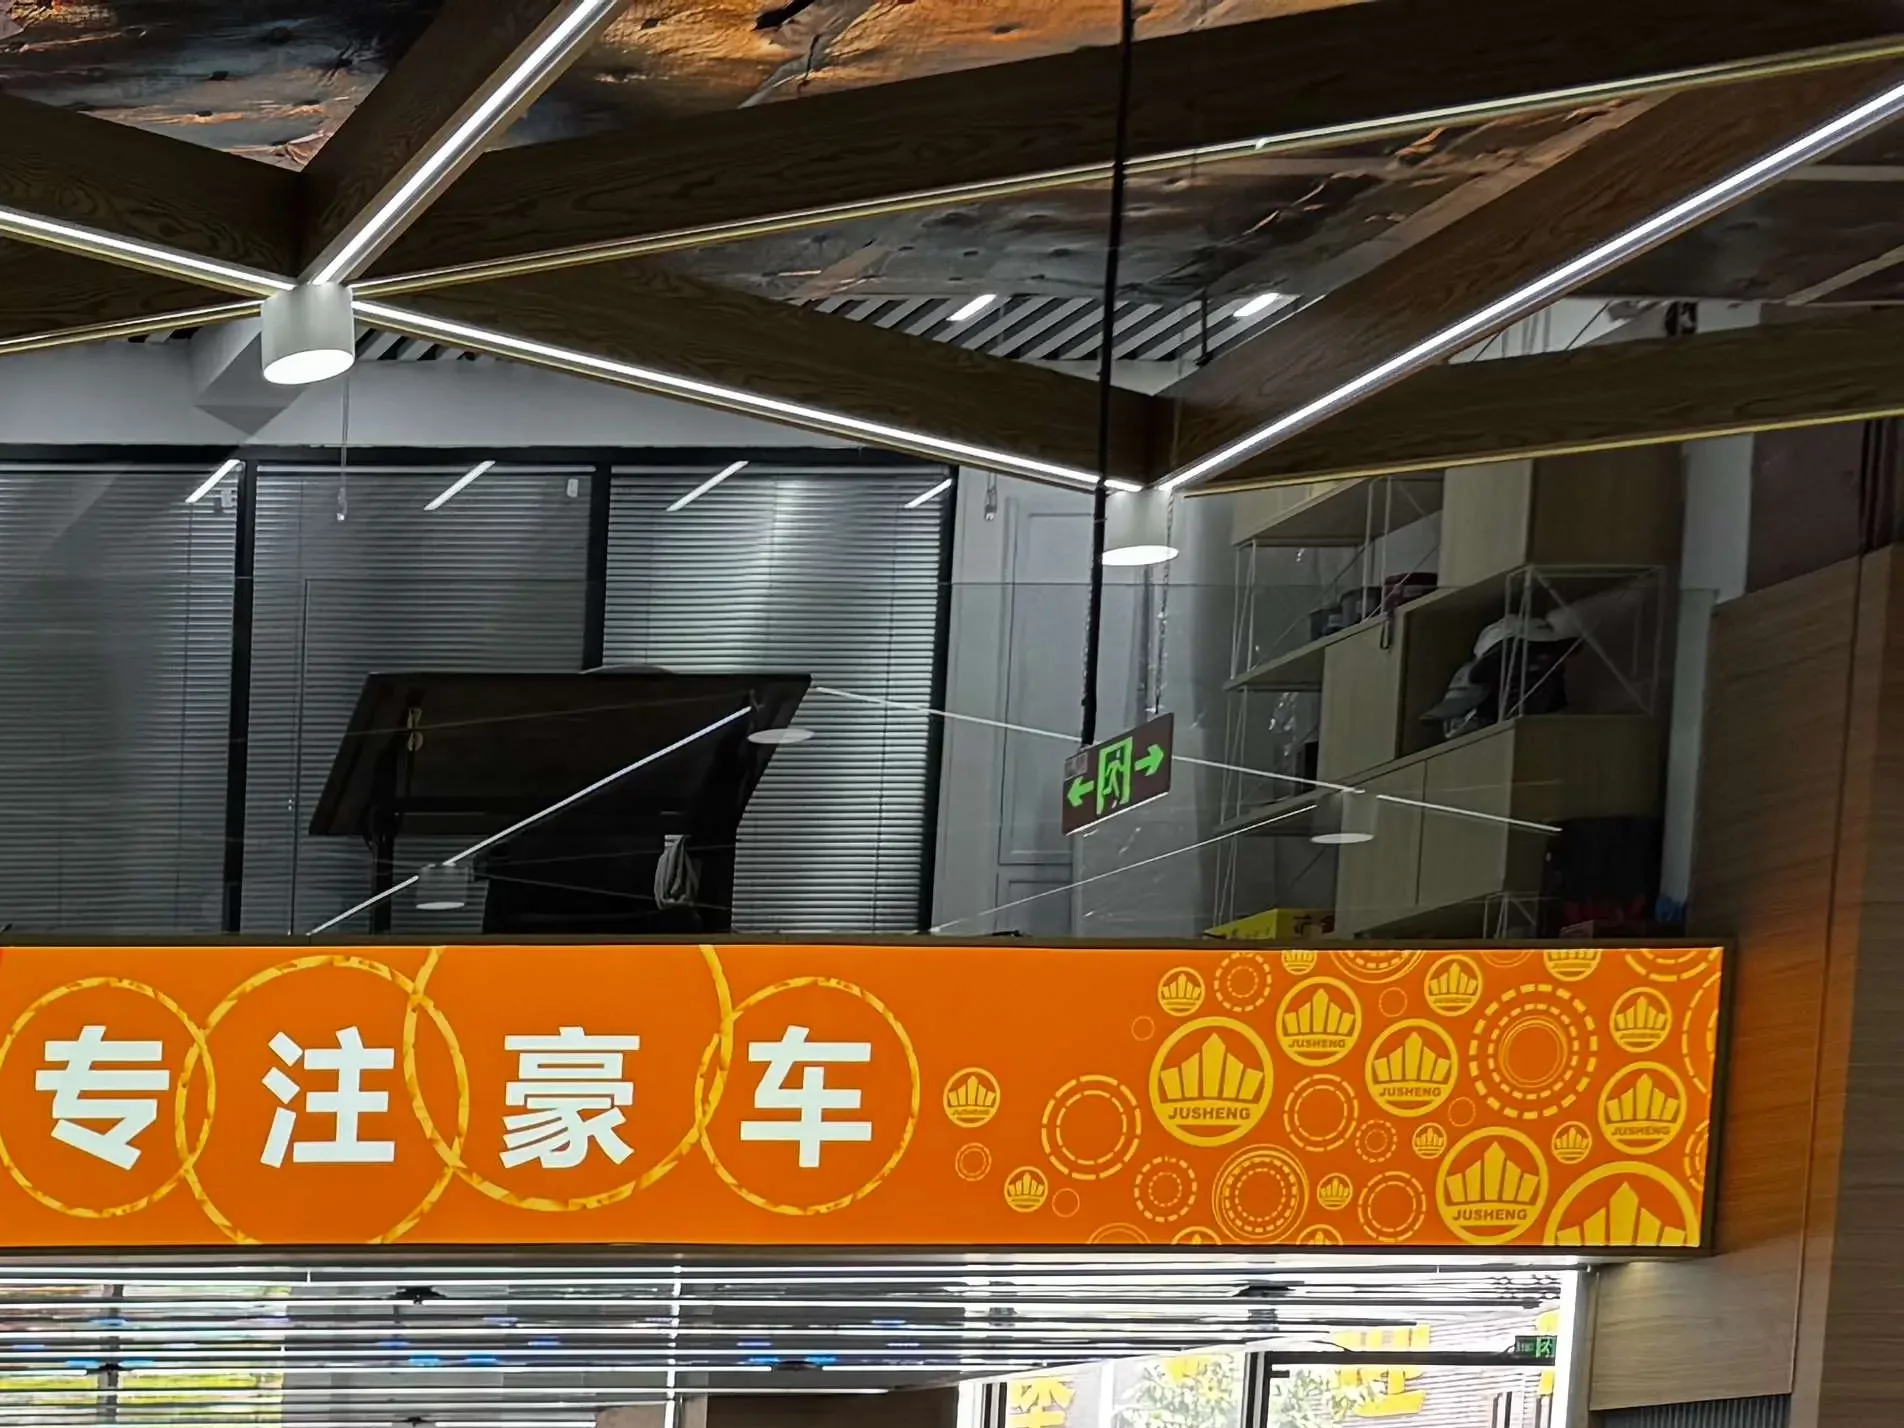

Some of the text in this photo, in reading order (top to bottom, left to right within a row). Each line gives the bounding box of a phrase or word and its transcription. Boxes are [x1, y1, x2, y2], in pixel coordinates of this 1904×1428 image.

[34, 1026, 873, 1170] 专注豪车
[1379, 1086, 1442, 1098] JUSHENG
[1168, 1107, 1251, 1121] JUSHENG
[1452, 1208, 1528, 1221] JUSHENG
